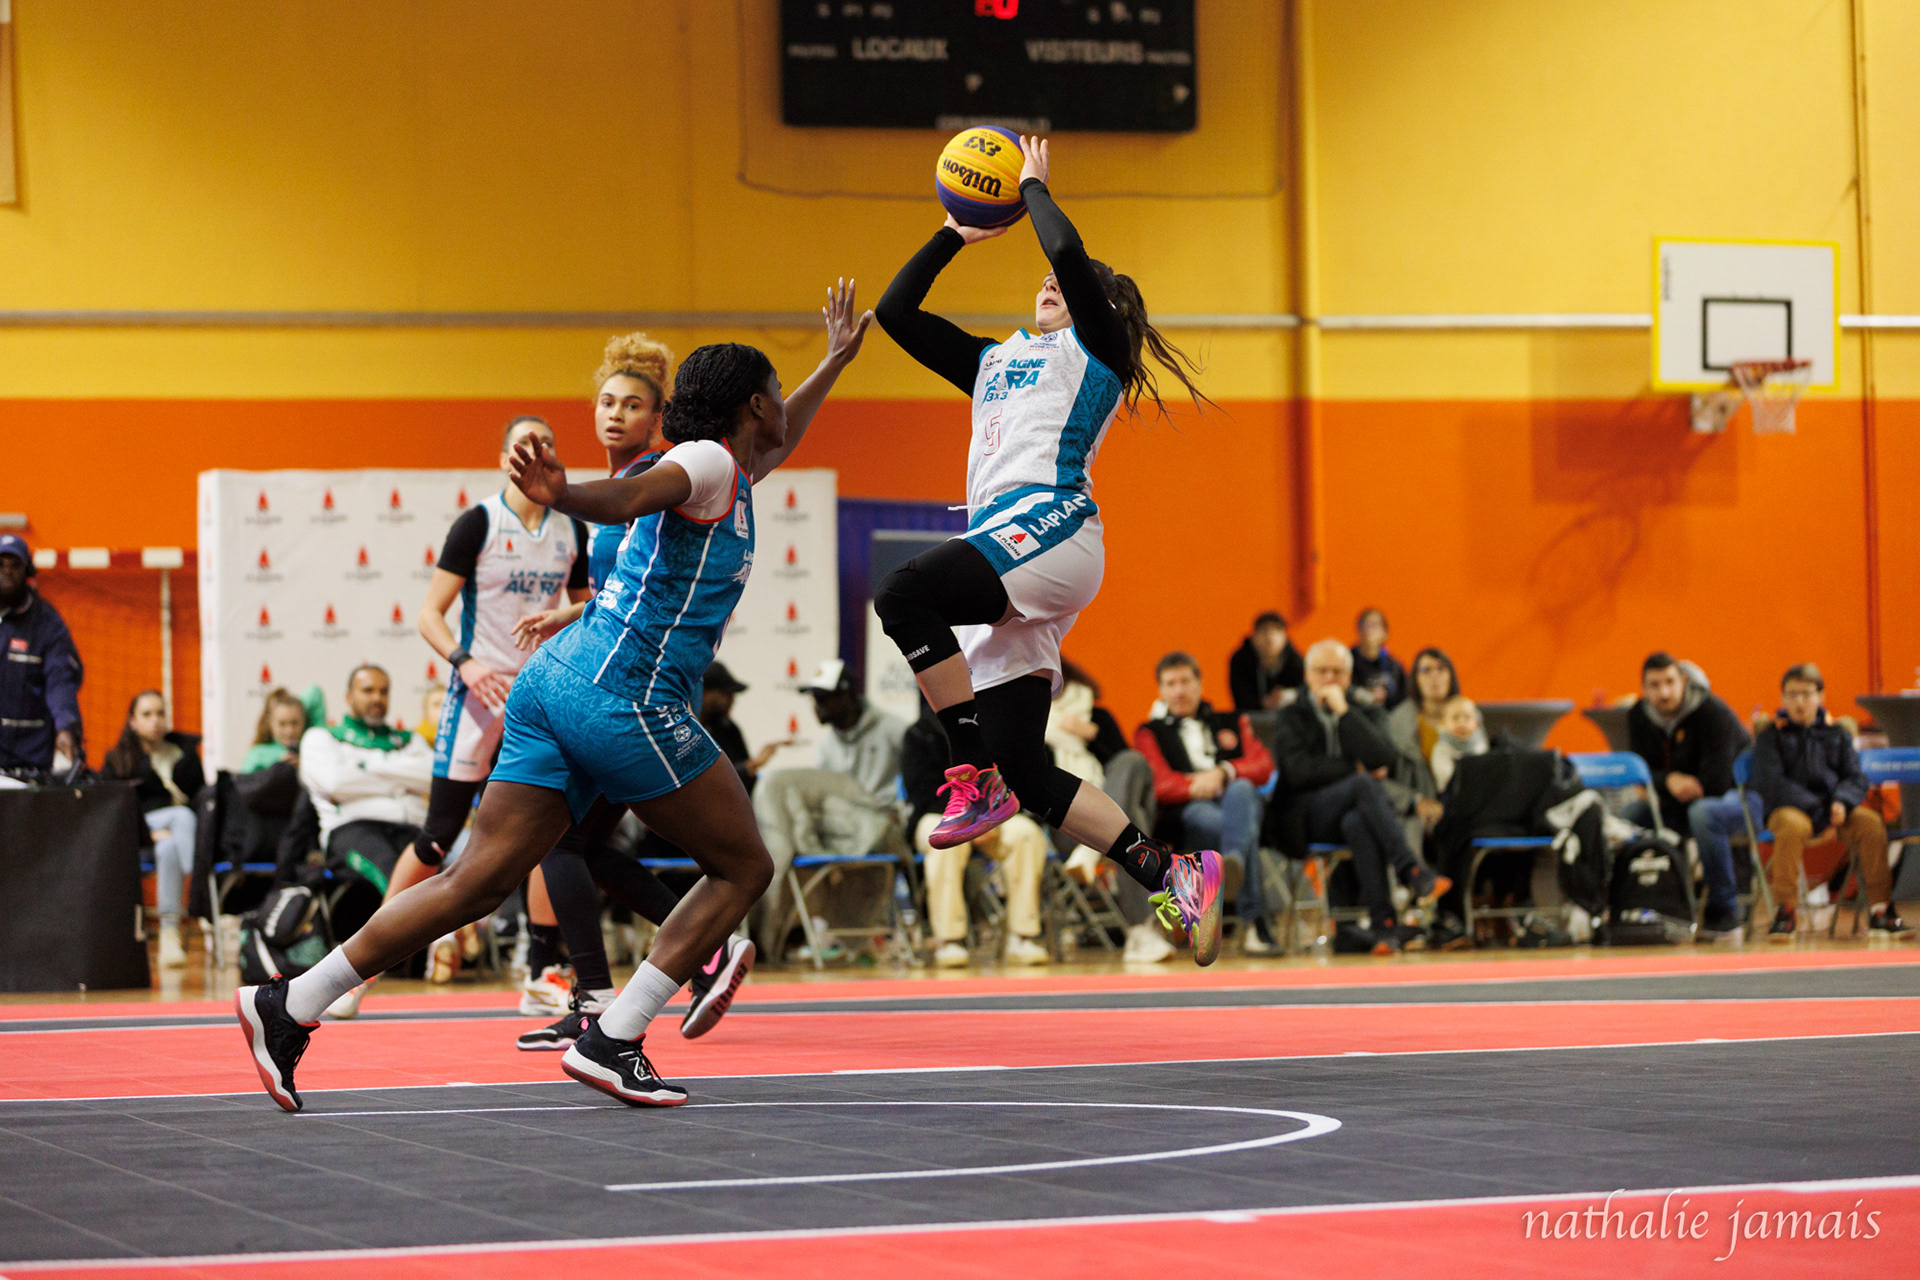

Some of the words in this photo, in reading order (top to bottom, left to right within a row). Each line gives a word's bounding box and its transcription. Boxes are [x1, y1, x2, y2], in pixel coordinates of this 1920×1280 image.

[852, 37, 949, 60] LOCAUX
[942, 156, 1002, 198] Wilson
[1006, 358, 1047, 369] AGNE
[983, 407, 1003, 456] 5
